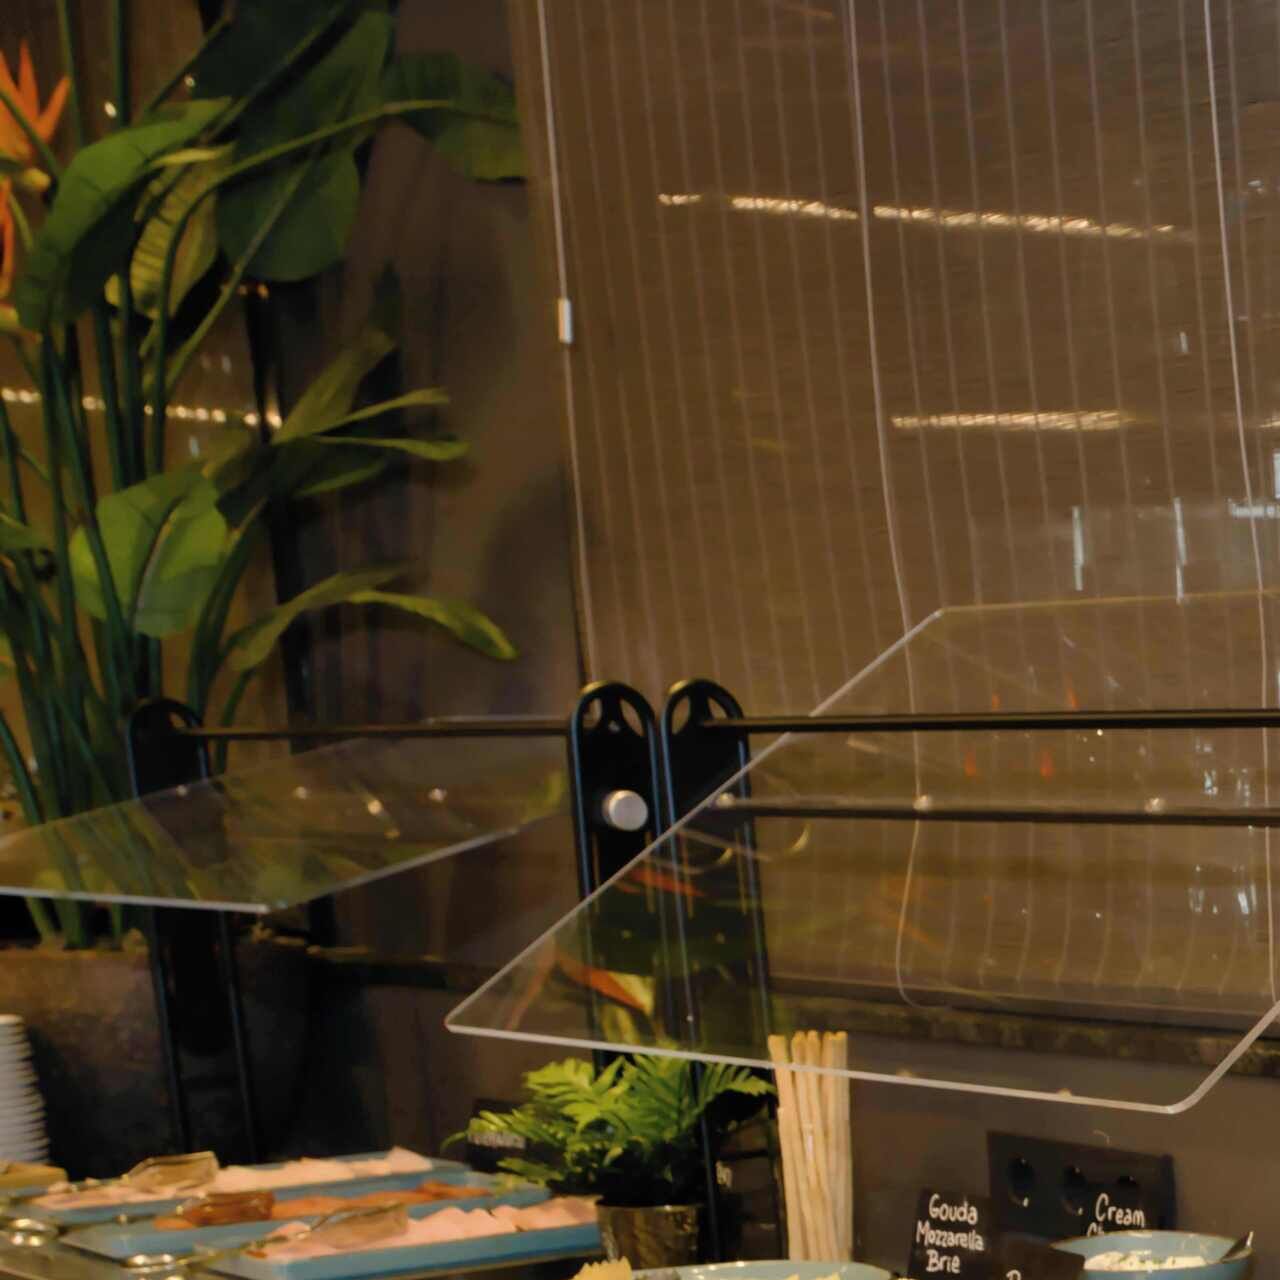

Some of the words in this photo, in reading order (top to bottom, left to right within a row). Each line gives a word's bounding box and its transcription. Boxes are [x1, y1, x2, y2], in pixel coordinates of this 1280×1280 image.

[928, 1193, 979, 1225] Gouda
[1095, 1192, 1145, 1228] Cream
[915, 1220, 985, 1252] Mozzarella
[925, 1250, 962, 1274] Brie
